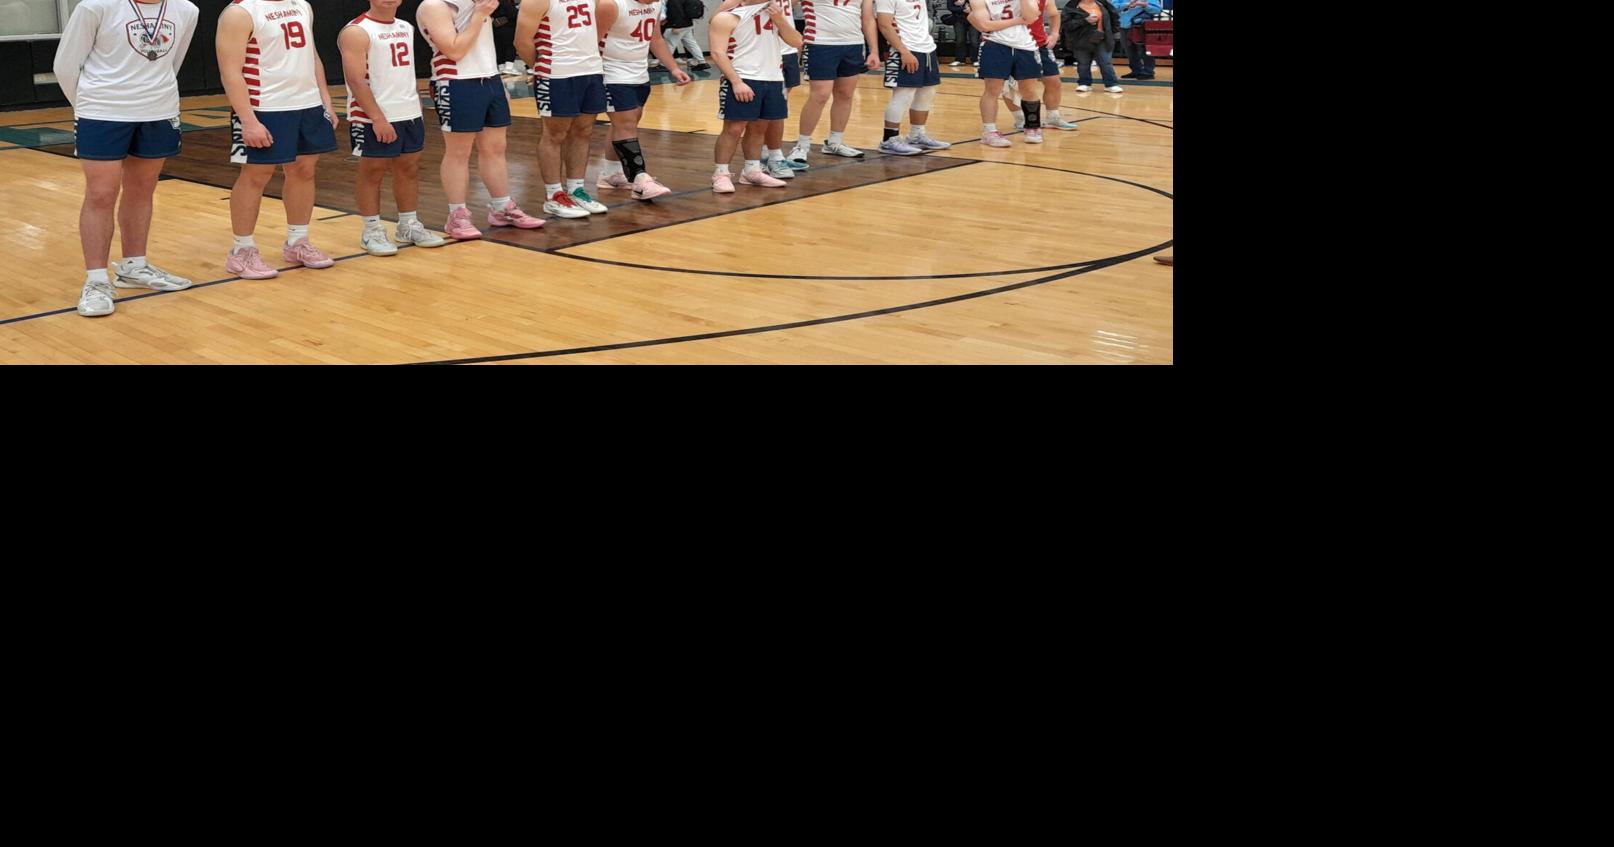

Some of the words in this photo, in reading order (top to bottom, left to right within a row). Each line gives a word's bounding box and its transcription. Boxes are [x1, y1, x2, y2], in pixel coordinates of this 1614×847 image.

[566, 3, 592, 29] 25
[753, 14, 774, 35] 14
[913, 4, 921, 20] 7
[1001, 4, 1014, 20] 5
[130, 22, 173, 32] NESHAINY
[280, 21, 306, 50] 19
[630, 18, 656, 42] 40
[389, 42, 411, 67] 12
[884, 51, 900, 84] SKINS
[536, 79, 551, 112] KINS
[231, 114, 247, 157] KINS
